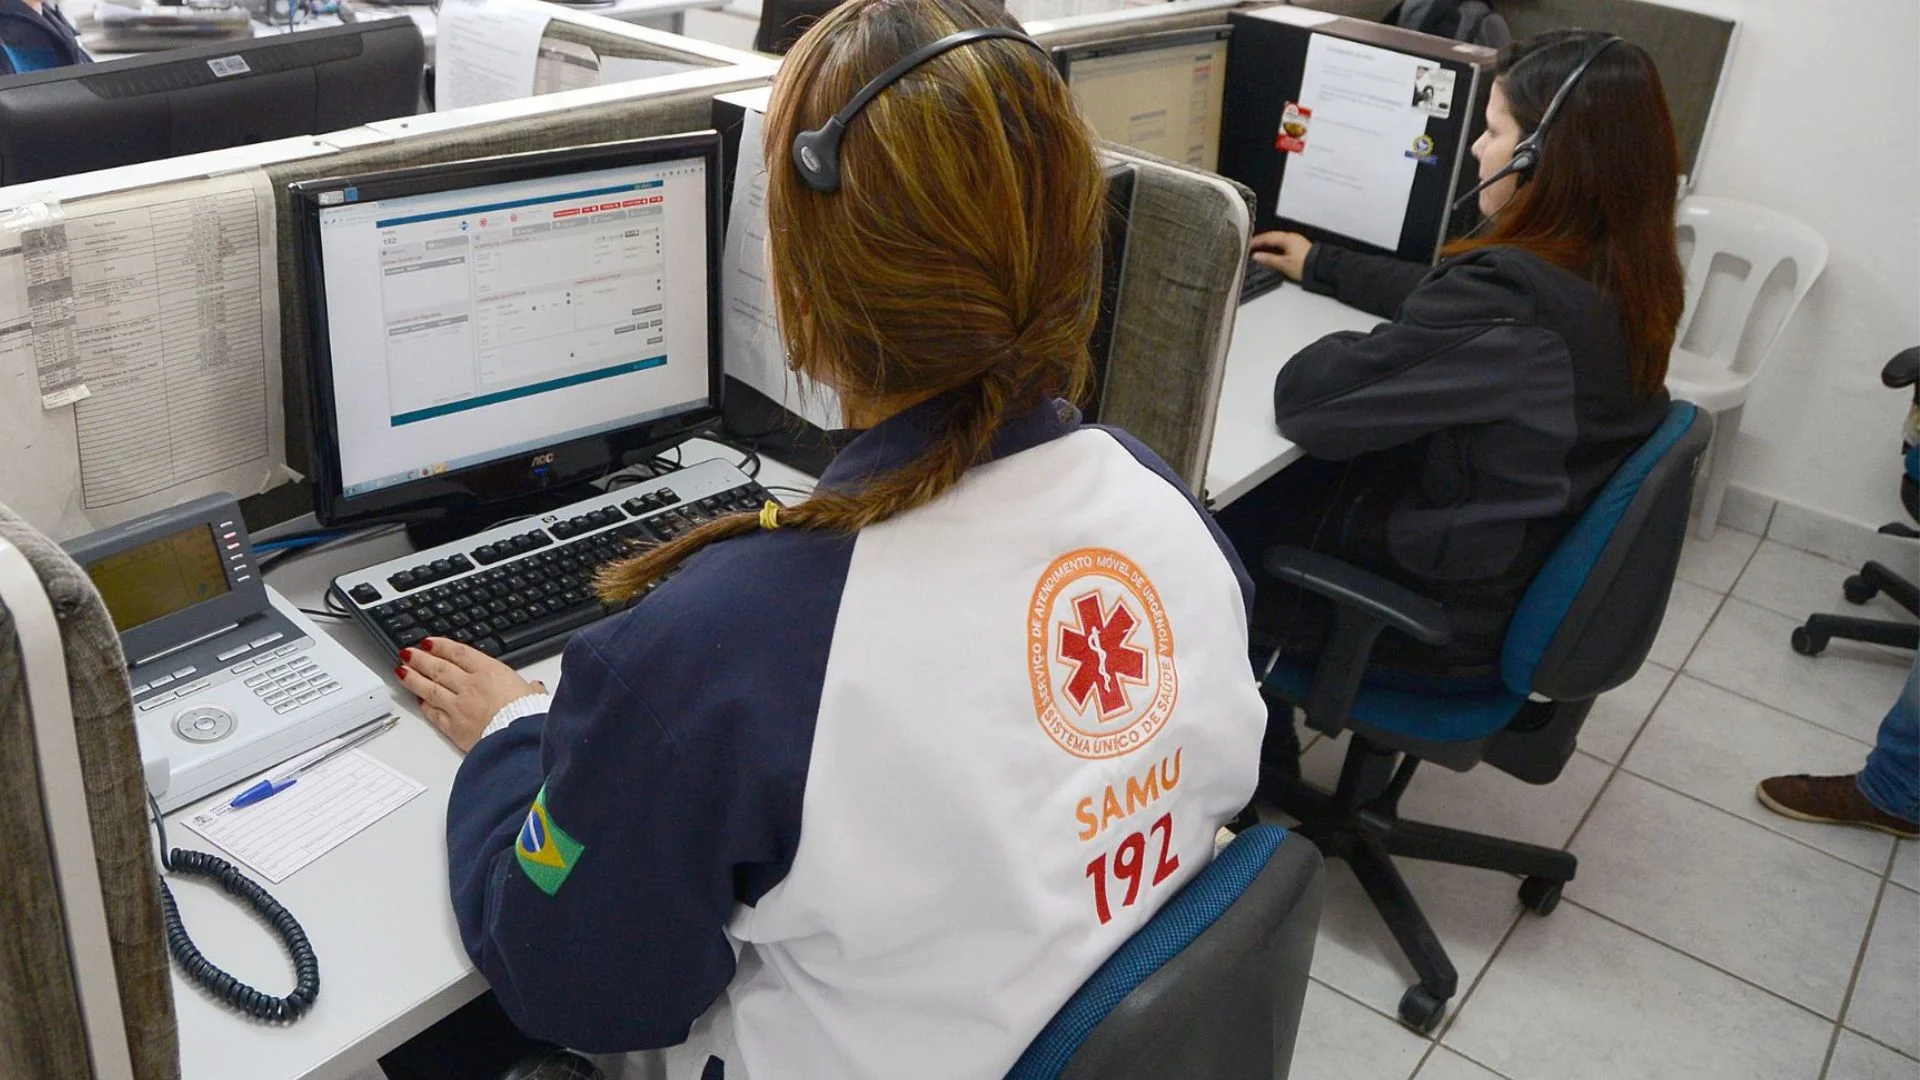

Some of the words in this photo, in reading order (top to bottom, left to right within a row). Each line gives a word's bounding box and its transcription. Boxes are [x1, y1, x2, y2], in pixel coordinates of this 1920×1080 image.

[531, 452, 554, 468] AOC
[1034, 555, 1092, 616] ATENDIMENTO
[1097, 553, 1130, 577] MÓVEL
[1130, 572, 1145, 588] DE
[1032, 619, 1042, 637] DE
[1142, 586, 1168, 653] URGÊNCIA
[1032, 643, 1050, 706] SERVIÇO
[1044, 709, 1090, 753] SISTEMA
[1093, 730, 1140, 754] ÚNICO
[1141, 711, 1161, 734] DE
[1158, 660, 1173, 712] SAÚDE
[1075, 746, 1182, 842] SAMU
[1085, 812, 1180, 925] 192
